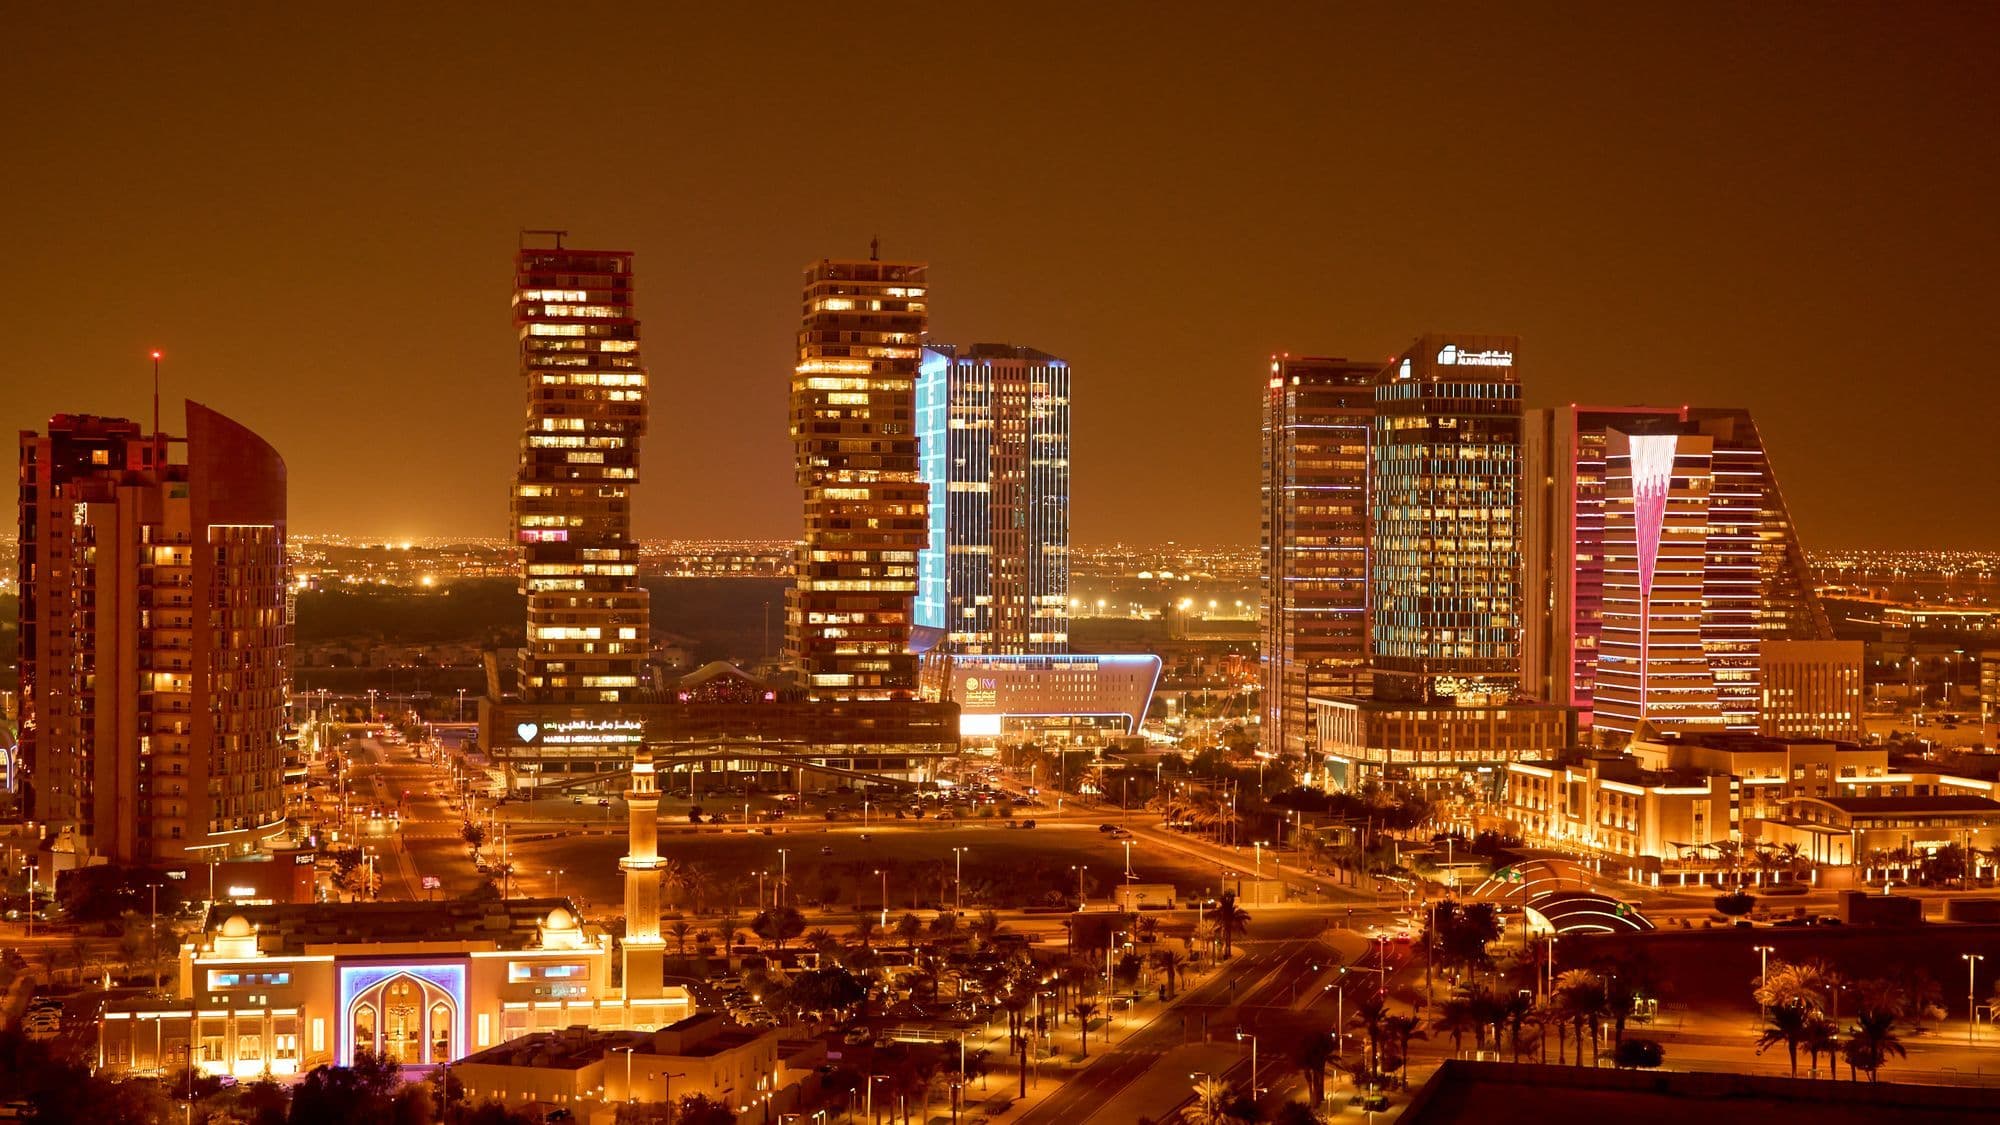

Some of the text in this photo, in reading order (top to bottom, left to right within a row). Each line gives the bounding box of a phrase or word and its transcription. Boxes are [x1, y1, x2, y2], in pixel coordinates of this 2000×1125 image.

[1491, 357, 1512, 366] BANK
[543, 735, 571, 743] MARBLE
[571, 735, 601, 743] MEDICAL
[601, 735, 628, 743] CENTER
